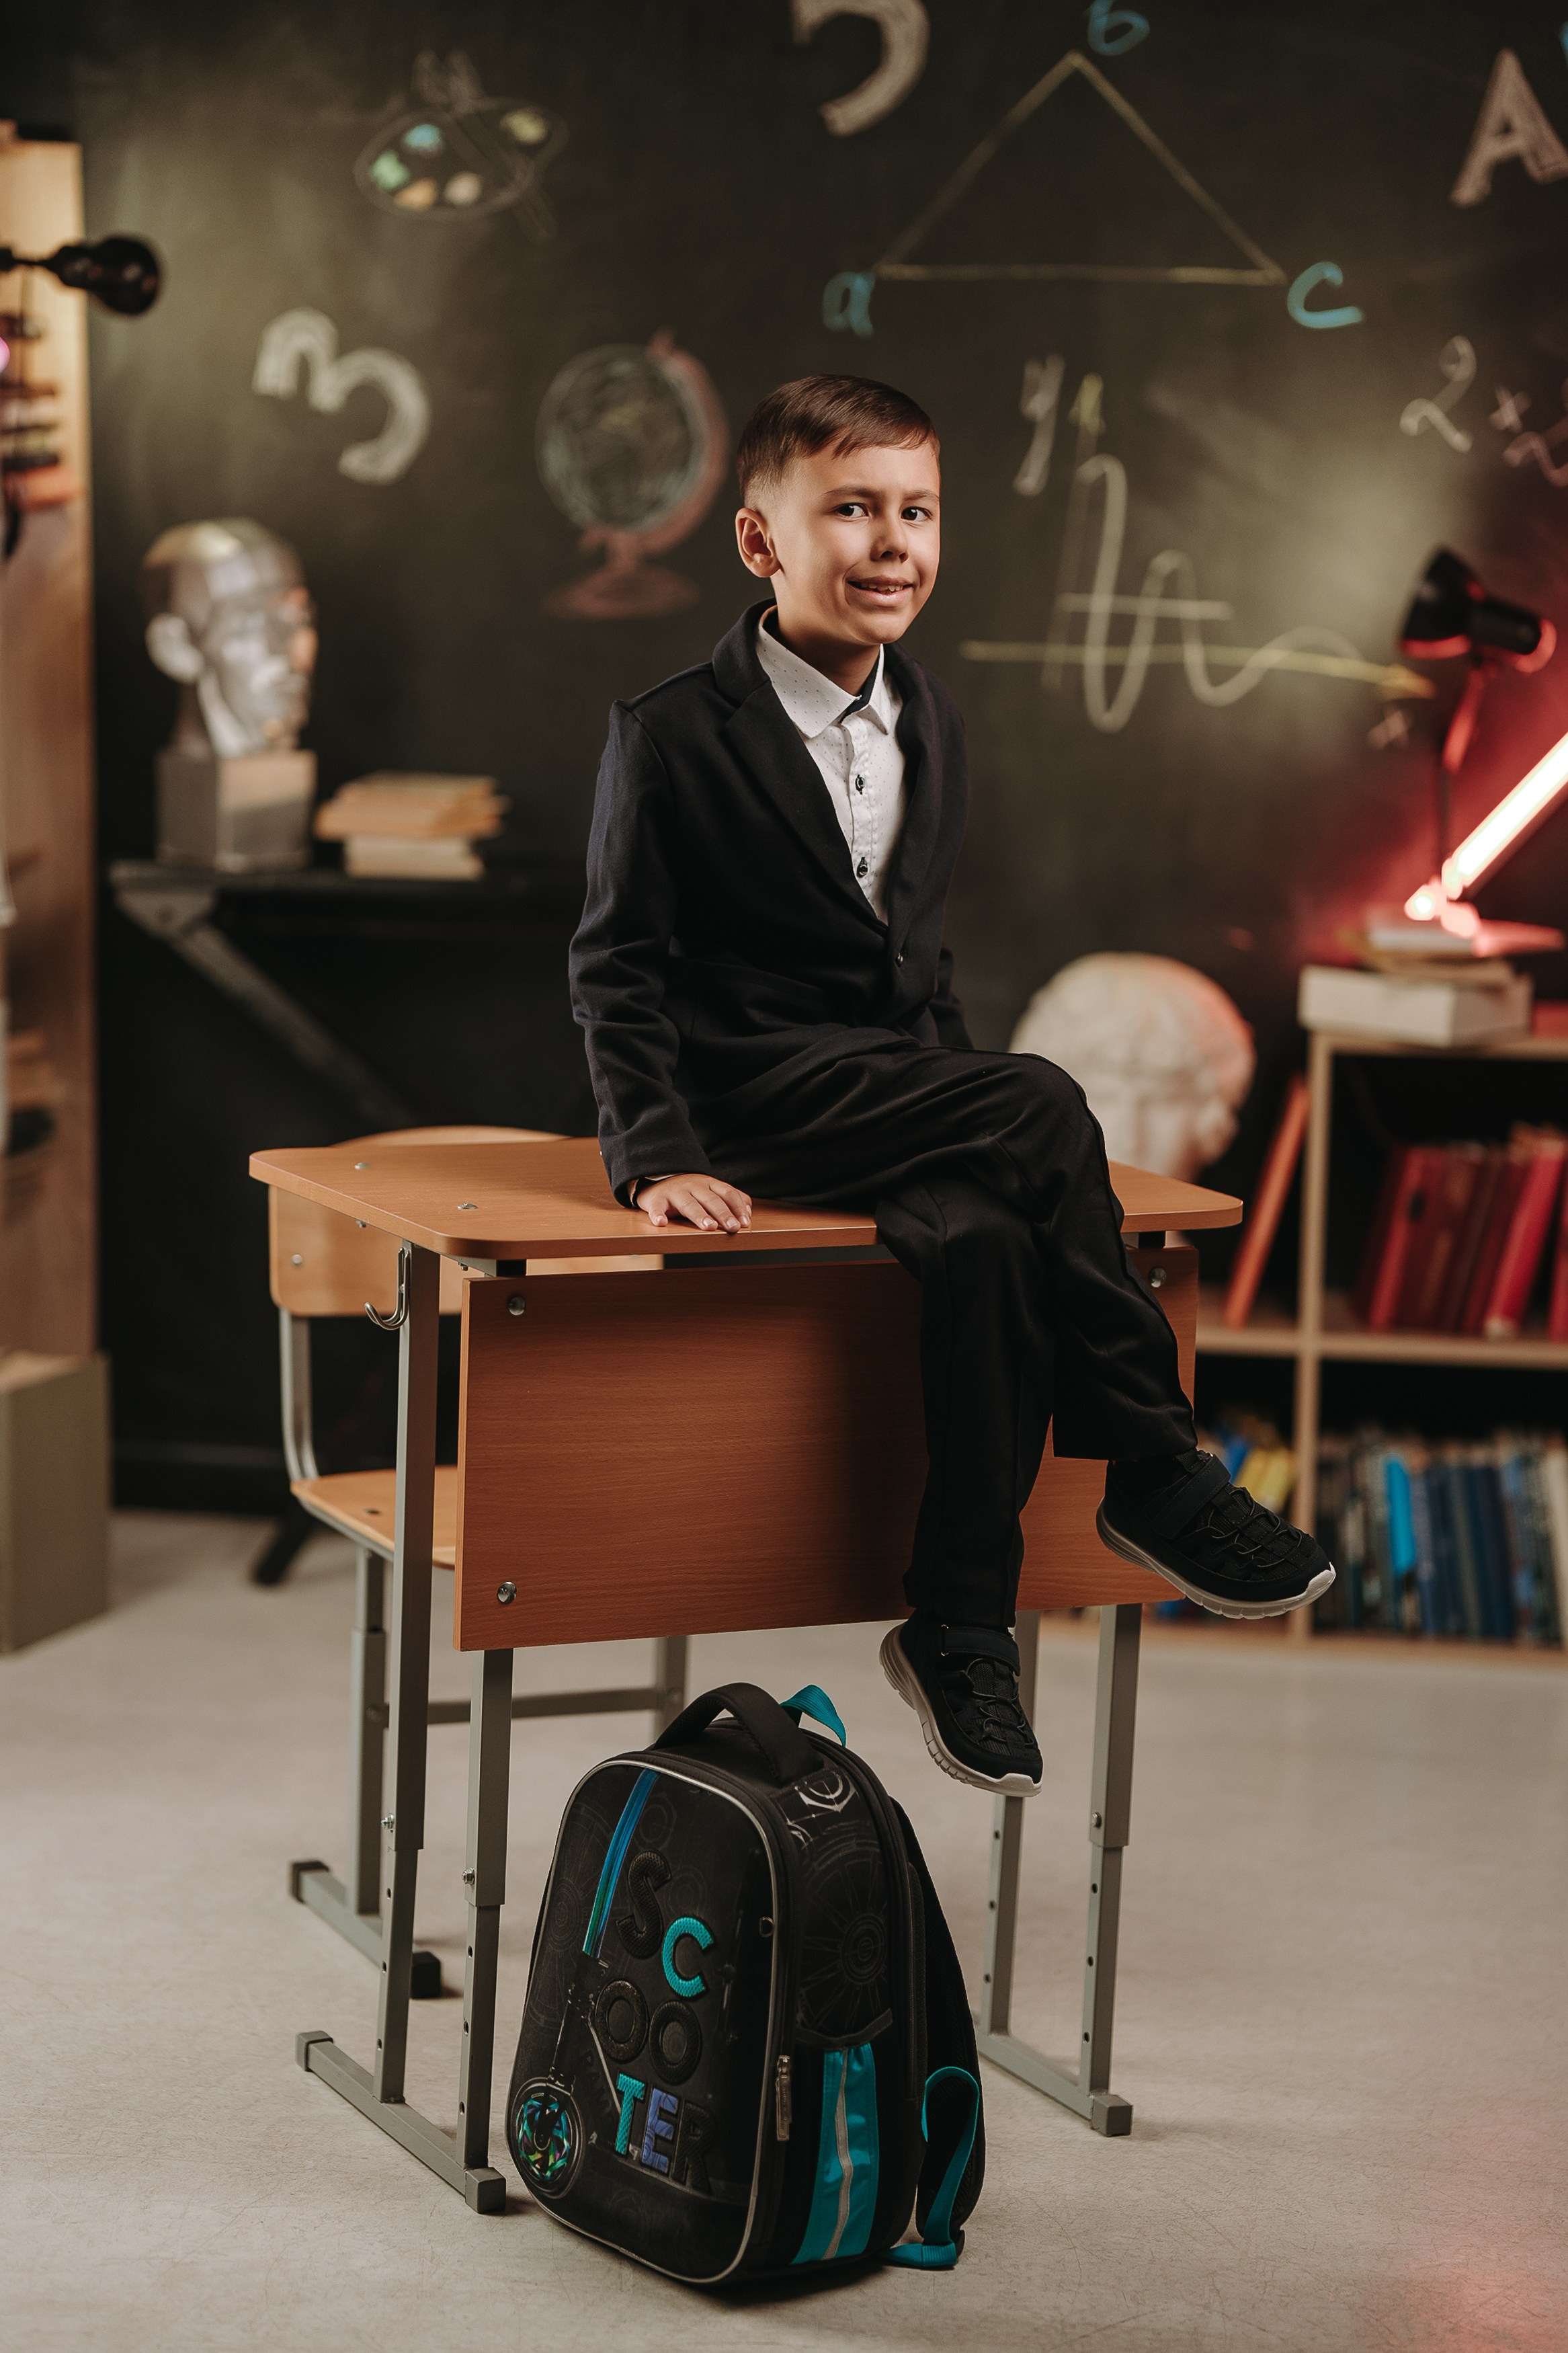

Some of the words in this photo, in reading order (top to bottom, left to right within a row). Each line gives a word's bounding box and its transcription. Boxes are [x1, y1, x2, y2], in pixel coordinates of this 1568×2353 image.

[1450, 46, 1568, 208] A
[252, 307, 431, 485] 3
[1399, 335, 1477, 452] 2
